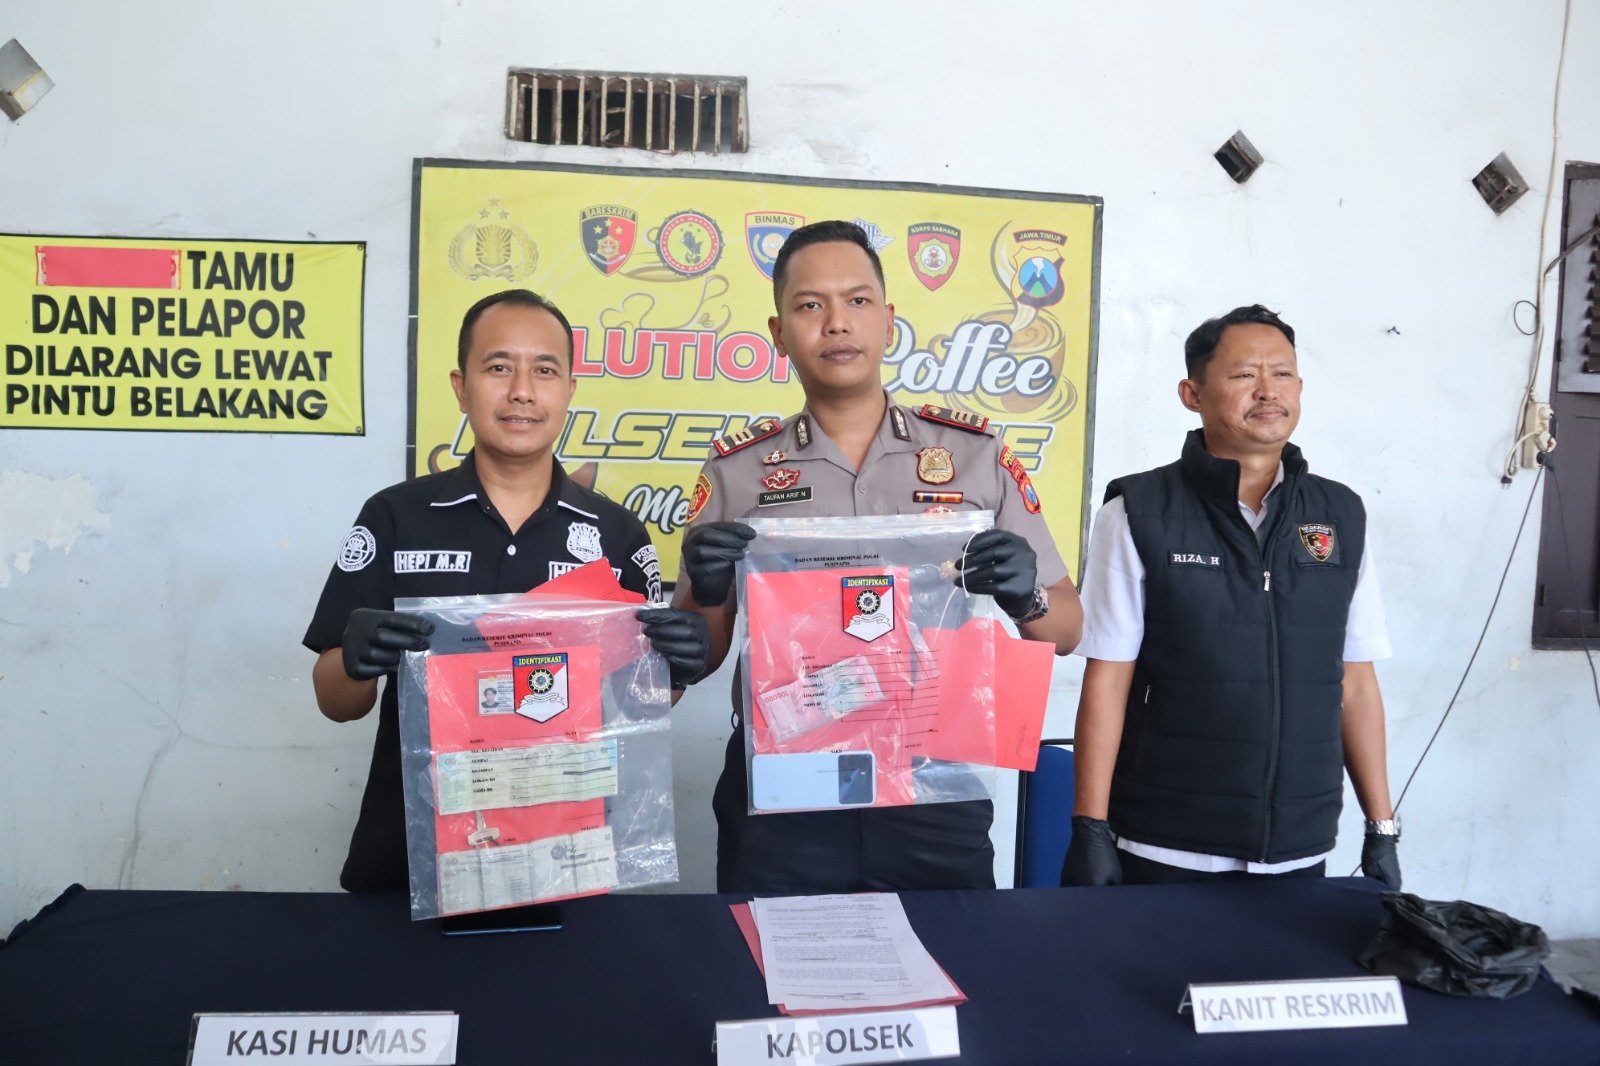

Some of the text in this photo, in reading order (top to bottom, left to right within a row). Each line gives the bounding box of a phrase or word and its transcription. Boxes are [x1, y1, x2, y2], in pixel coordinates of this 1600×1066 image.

[585, 206, 633, 219] BARESKRIM
[755, 215, 795, 225] BINMAS
[911, 225, 931, 233] KORPS
[1019, 232, 1062, 243] JAWA TIMUR
[187, 251, 294, 292] TAMU
[32, 294, 305, 340] DAN PELAPOR
[5, 344, 333, 382] DILARANG LEWAT
[5, 384, 328, 421] PINTU BELAKANG
[764, 493, 785, 501] TAUFAN
[785, 491, 800, 499] ARIF
[398, 552, 467, 570] HEPI M.R
[1211, 556, 1220, 566] H
[847, 578, 889, 587] IDENTIFIKASI
[518, 656, 562, 665] IDENTIFIKASI
[1200, 991, 1397, 1022] KANIT RESKRIM
[226, 1027, 427, 1056] KASI HUMAS
[766, 1022, 914, 1059] KAPOLSEK
